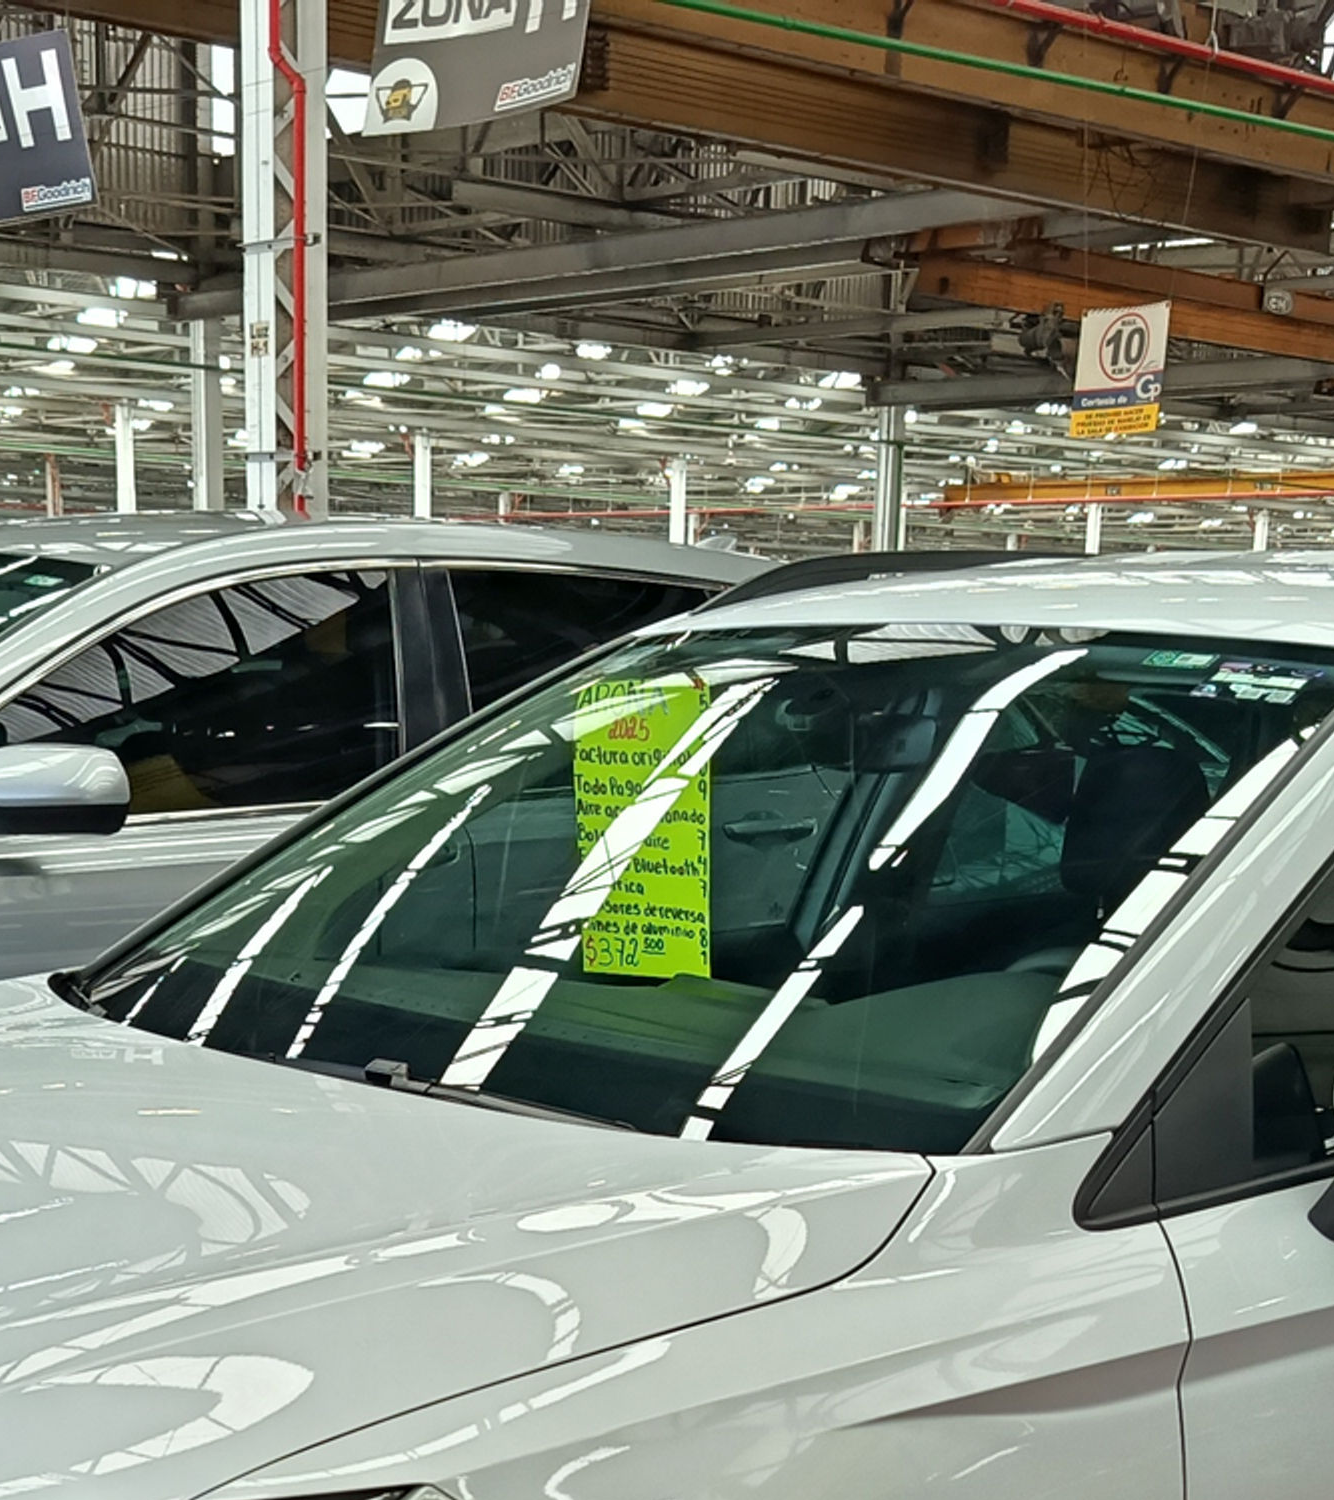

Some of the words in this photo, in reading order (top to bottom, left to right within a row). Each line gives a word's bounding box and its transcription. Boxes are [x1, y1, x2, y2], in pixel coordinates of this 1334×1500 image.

[1, 49, 72, 148] H
[22, 177, 91, 203] BFGoodrich
[1105, 326, 1145, 366] 10
